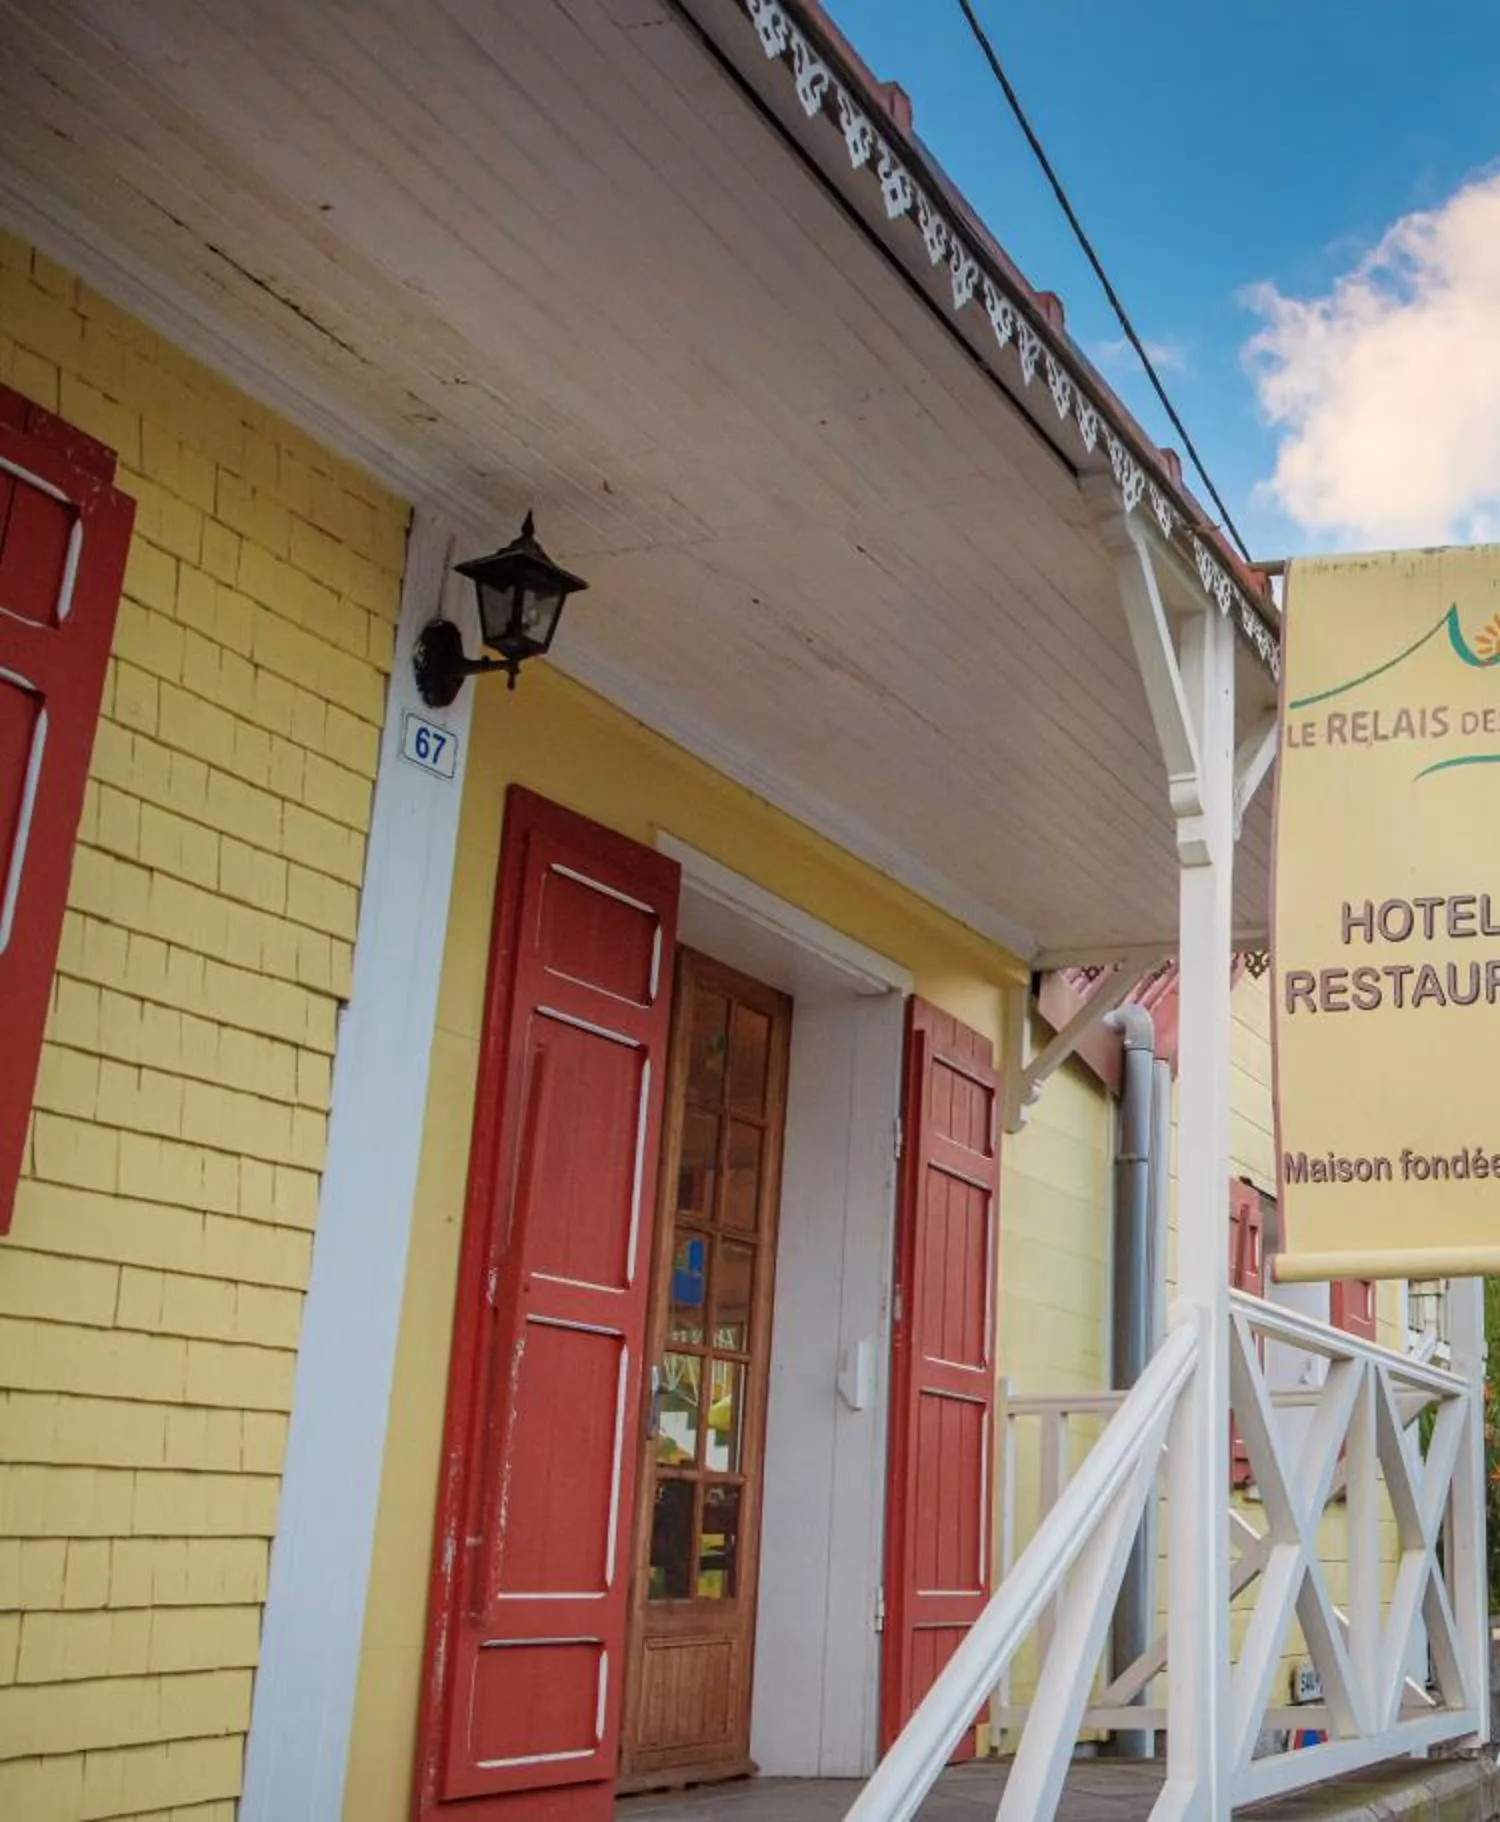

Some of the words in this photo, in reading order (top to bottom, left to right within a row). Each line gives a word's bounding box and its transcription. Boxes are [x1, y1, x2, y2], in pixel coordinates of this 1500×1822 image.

[415, 727, 446, 764] 67
[1287, 722, 1317, 748] LE
[1327, 706, 1450, 745] RELAIS
[1285, 1152, 1393, 1184] Maison
